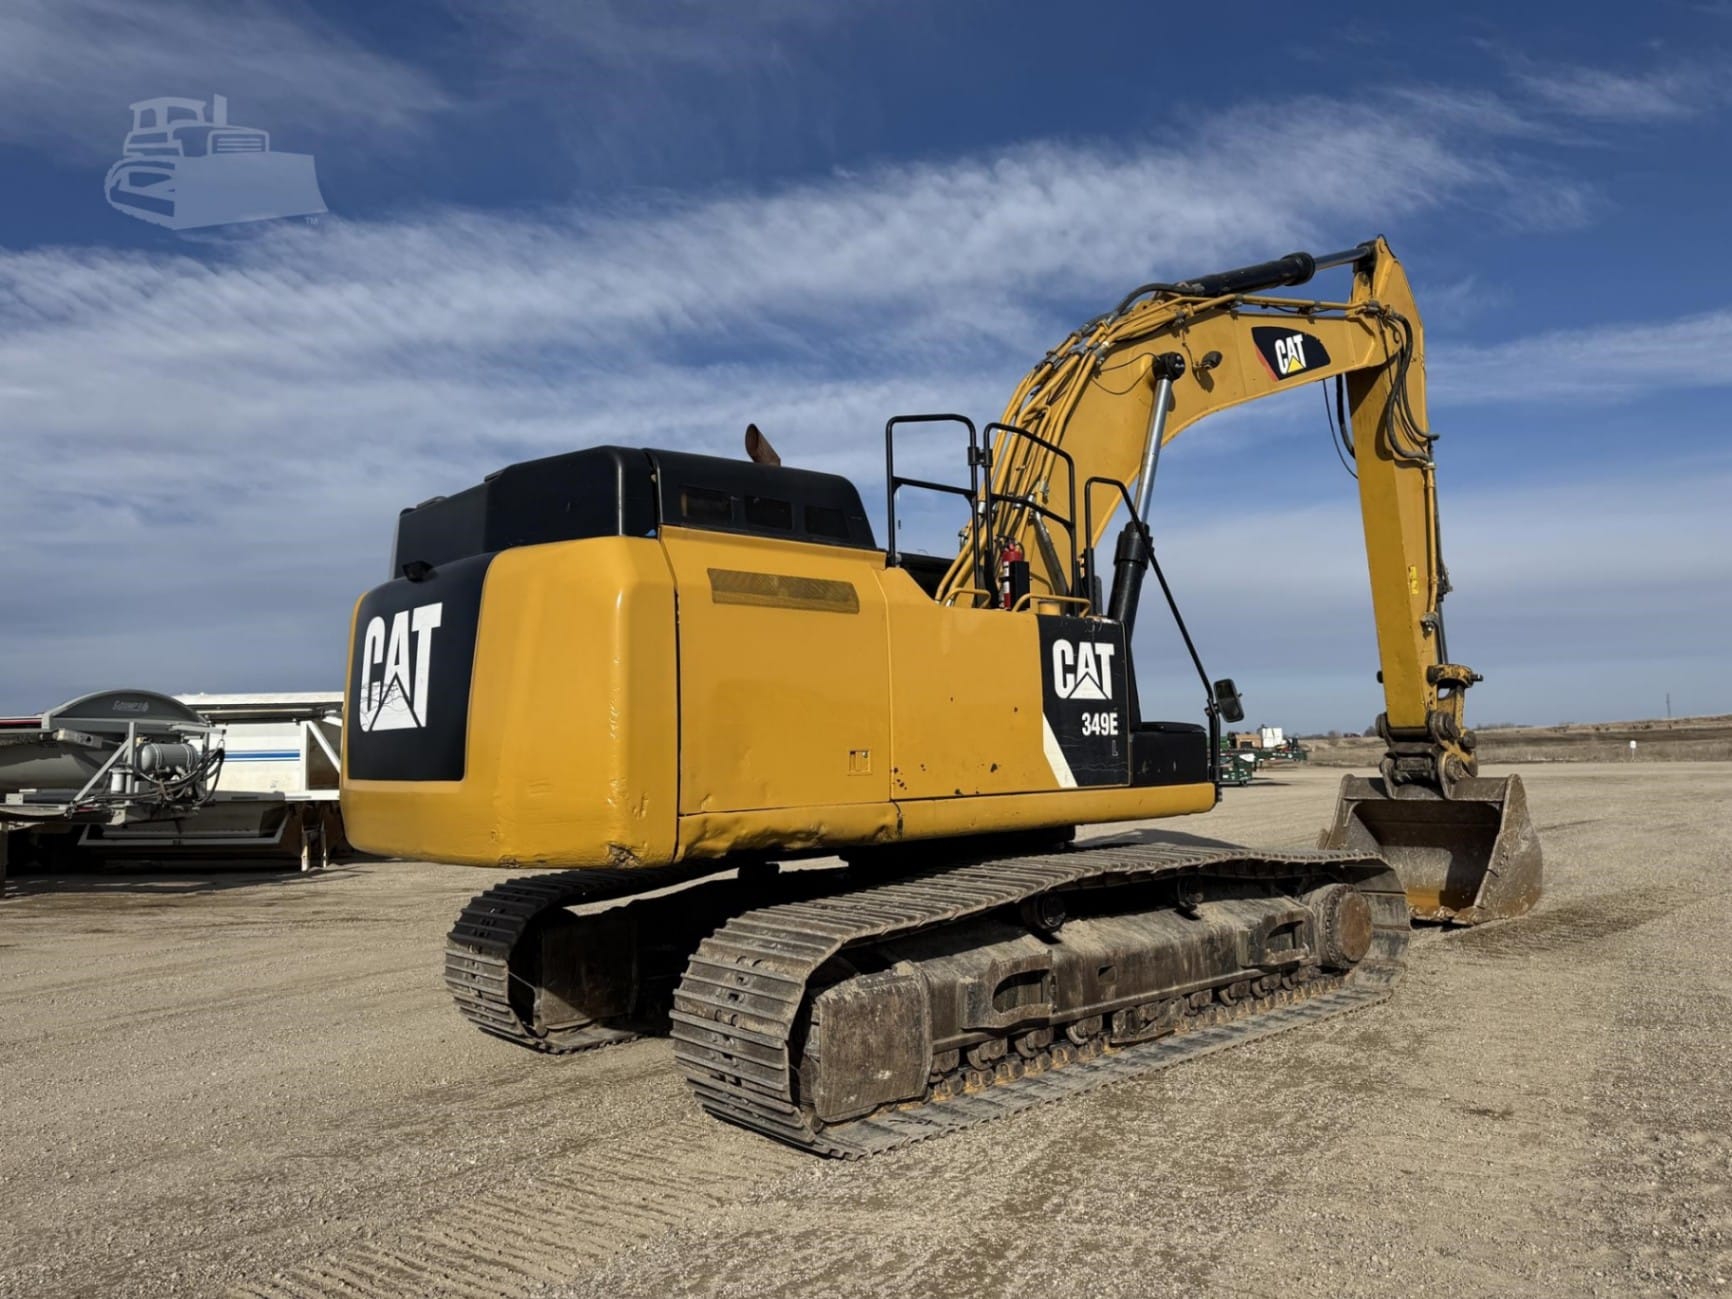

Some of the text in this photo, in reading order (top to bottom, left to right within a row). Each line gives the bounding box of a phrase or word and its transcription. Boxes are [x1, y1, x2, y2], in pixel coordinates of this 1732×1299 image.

[1274, 333, 1307, 375] CAT
[359, 601, 443, 733] CAT
[1052, 638, 1115, 700] CAT
[1081, 711, 1119, 736] 349E
